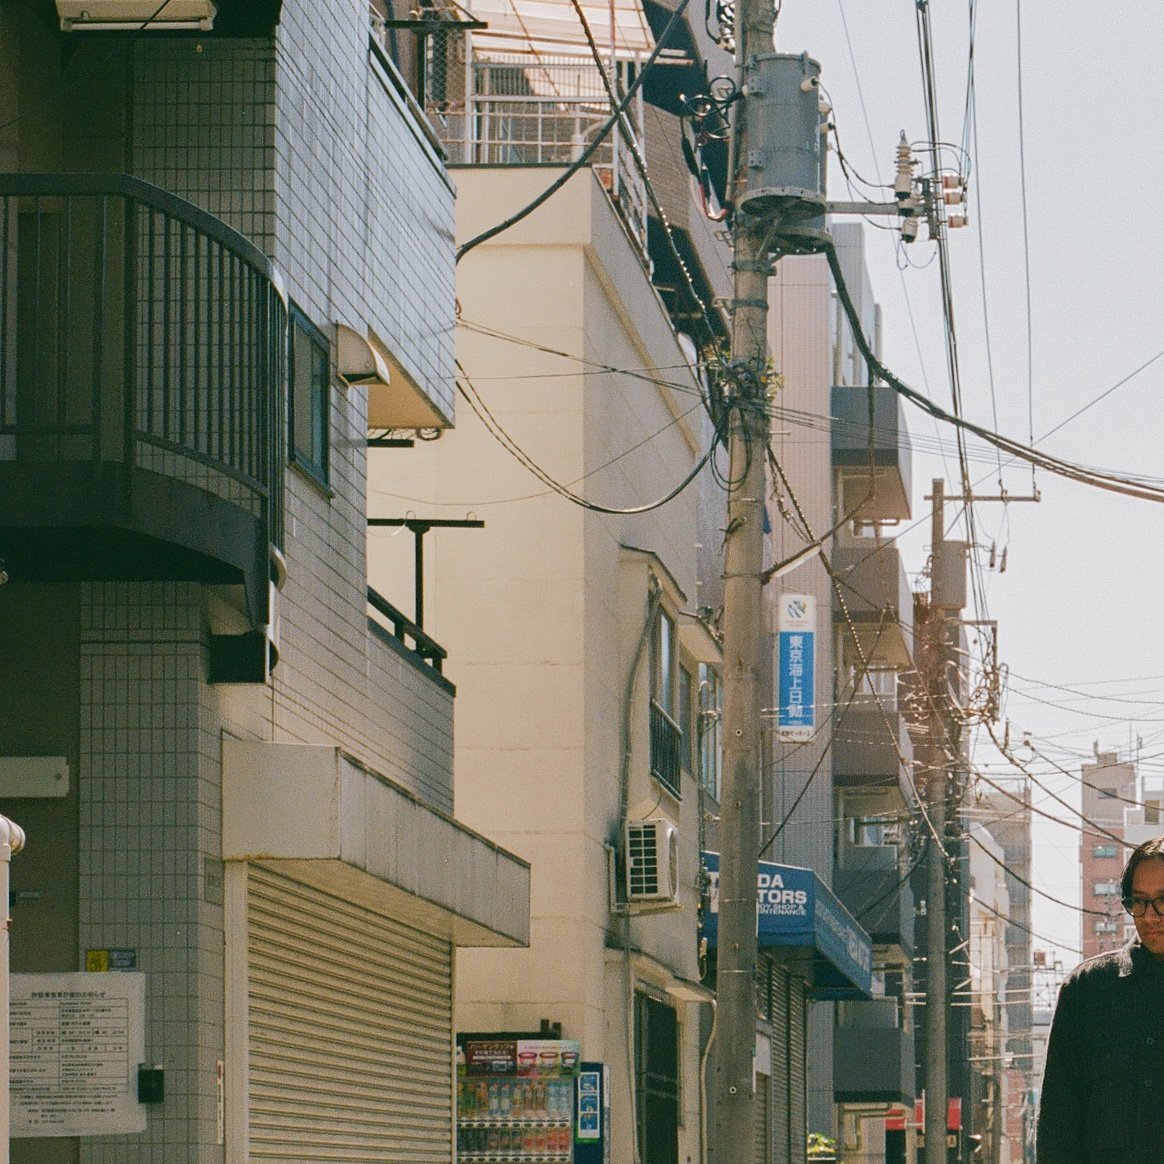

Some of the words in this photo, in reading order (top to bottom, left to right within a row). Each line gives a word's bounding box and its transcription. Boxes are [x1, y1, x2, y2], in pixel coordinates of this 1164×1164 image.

[788, 635, 804, 718] 東京海上日動
[757, 873, 784, 888] DA
[757, 889, 807, 904] TORS
